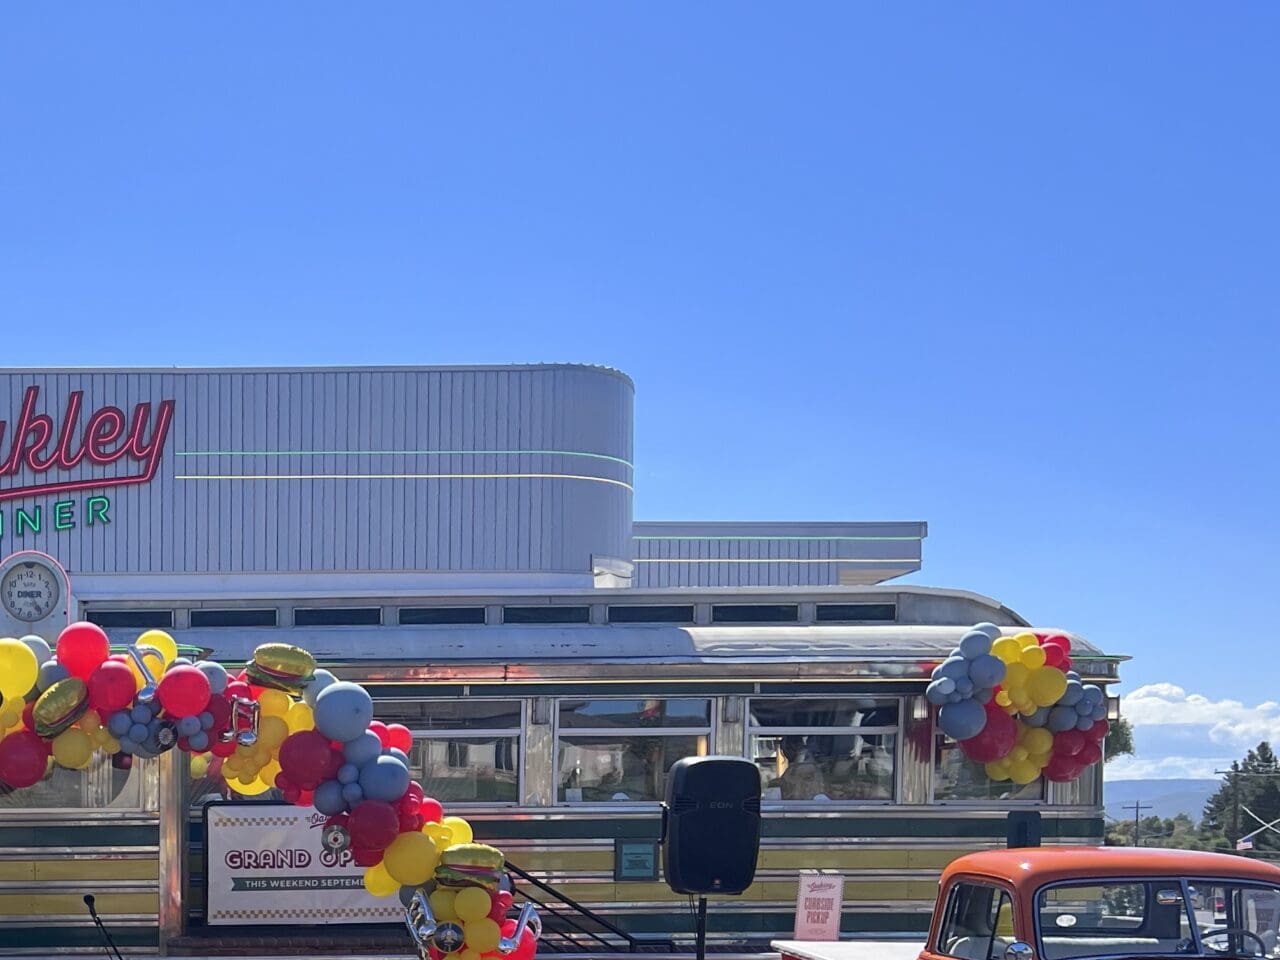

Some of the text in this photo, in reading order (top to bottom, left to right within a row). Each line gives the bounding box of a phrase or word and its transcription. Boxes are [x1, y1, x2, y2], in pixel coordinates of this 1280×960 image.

[17, 590, 42, 598] DINER
[224, 848, 362, 869] GRAND OP
[245, 880, 267, 888] THIS
[269, 879, 319, 888] WEEKEND
[806, 911, 829, 924] PICKUP
